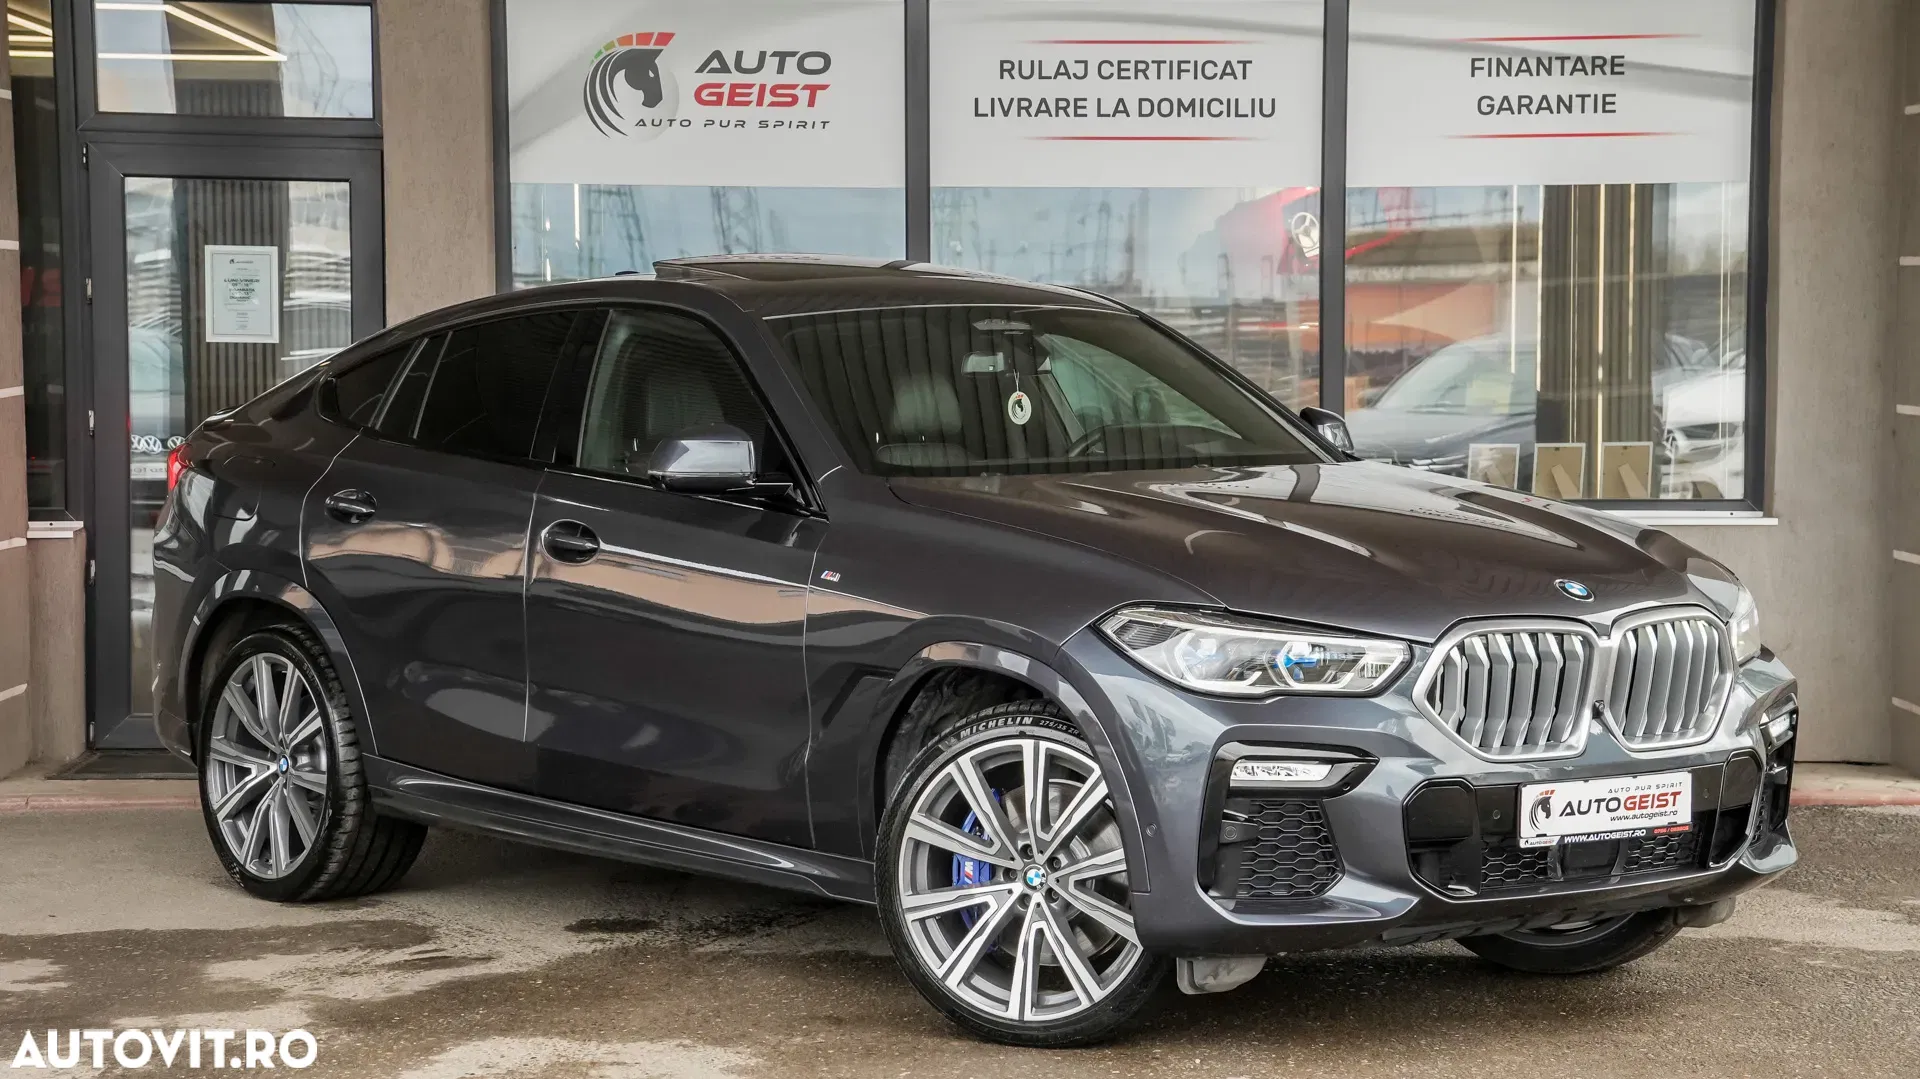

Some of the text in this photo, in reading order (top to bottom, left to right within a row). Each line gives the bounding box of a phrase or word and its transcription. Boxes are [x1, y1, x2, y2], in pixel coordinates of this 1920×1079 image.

[694, 50, 832, 76] AUTO
[999, 59, 1253, 81] RULAJ CERTIFICAT
[1470, 55, 1625, 78] FINANTARE
[693, 82, 831, 108] GEIST
[1477, 93, 1617, 116] GARANTIE
[974, 97, 1276, 118] LIVRARE LA DOMICILIU
[634, 118, 831, 130] AUTO PUR SPIRIT
[960, 716, 1034, 739] MICHELIN
[1039, 720, 1067, 731] 275/35
[1607, 786, 1631, 794] AUTO
[1655, 781, 1683, 790] SPIRIT
[1558, 791, 1683, 818] AUTOGEIST
[1610, 810, 1678, 822] www.autogeist.ro
[1564, 829, 1647, 844] WWW.AUTOGEIST.RO
